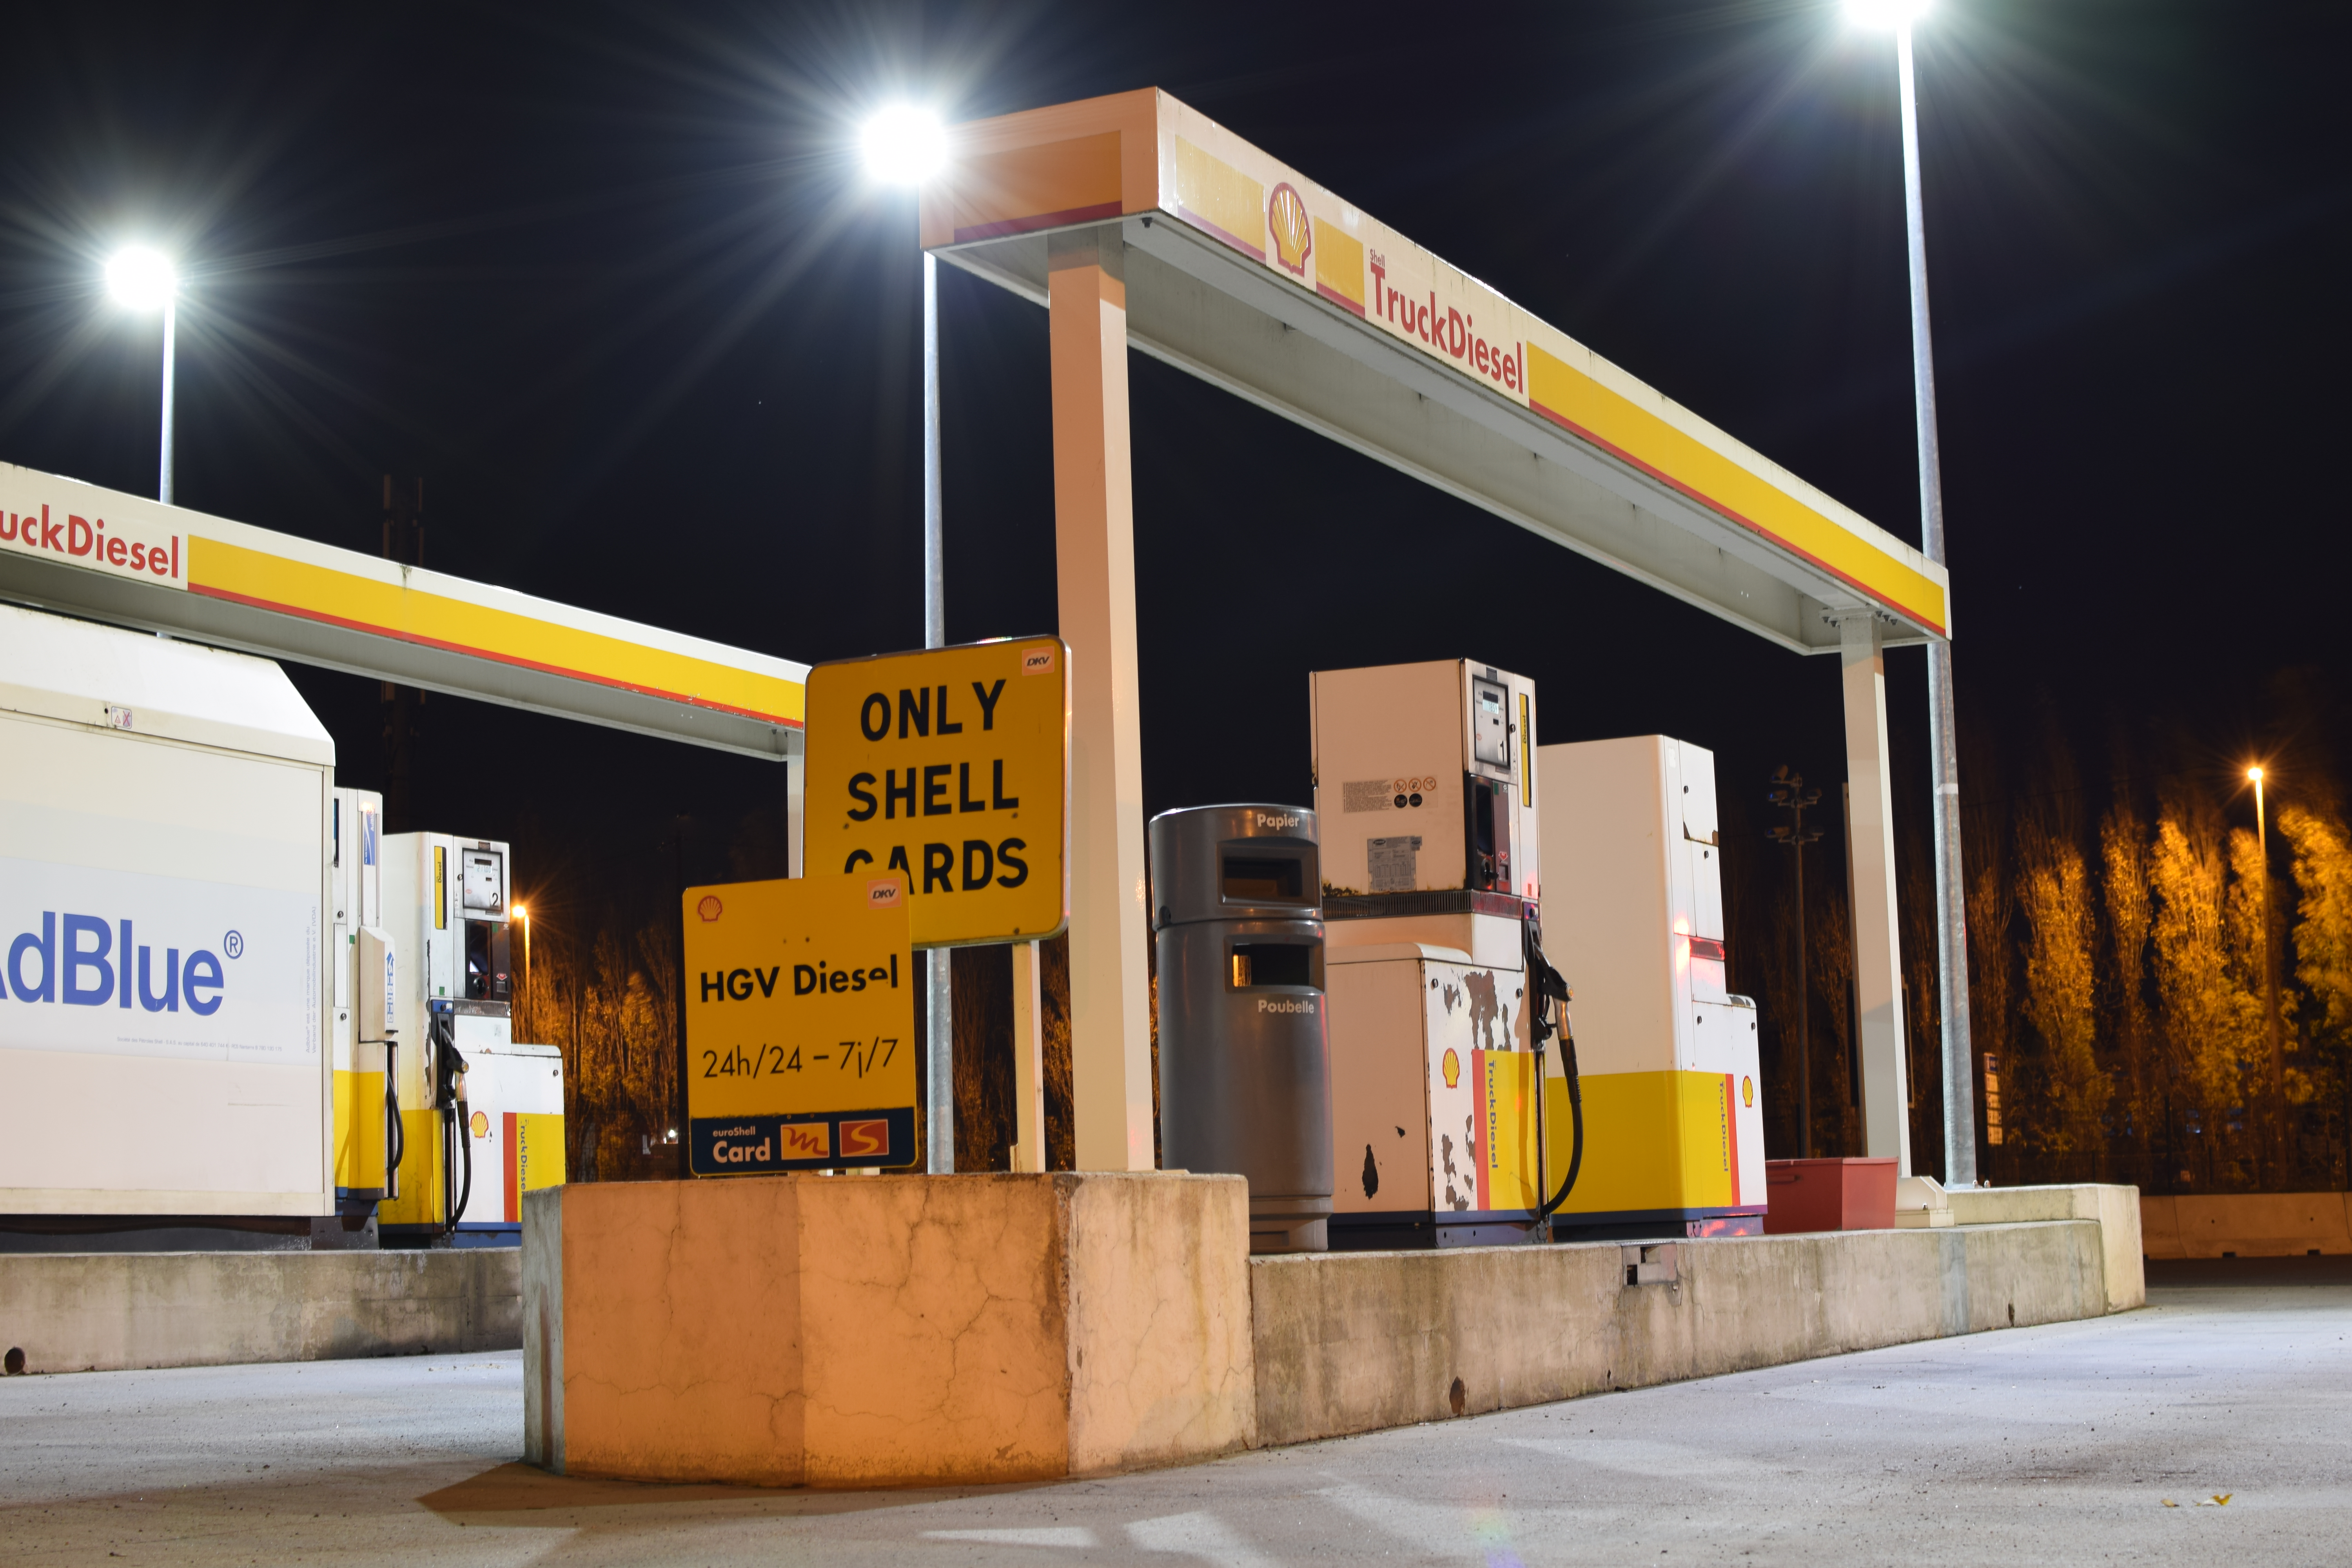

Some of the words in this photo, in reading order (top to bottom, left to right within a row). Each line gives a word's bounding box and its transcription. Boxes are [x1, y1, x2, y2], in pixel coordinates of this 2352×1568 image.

[1370, 249, 1385, 268] Shell
[1370, 261, 1523, 394] TruckDiesel
[1027, 656, 1050, 667] DKV
[860, 679, 1006, 742] ONLY
[1500, 740, 1504, 762] 1
[847, 759, 1019, 822] SHELL
[1257, 813, 1299, 830] Papier
[492, 893, 499, 907] 2
[873, 888, 896, 900] DKV
[306, 927, 310, 935] du
[701, 966, 780, 1003] HGV
[794, 954, 898, 996] Diesel
[1258, 1000, 1314, 1014] Poubelle
[703, 1043, 802, 1079] 24h/24
[839, 1036, 898, 1079] 7j/7
[1488, 1060, 1498, 1168] TruckDiesel
[713, 1126, 756, 1136] euroShell
[1719, 1081, 1728, 1171] TruckDiesel
[713, 1137, 770, 1163] Card
